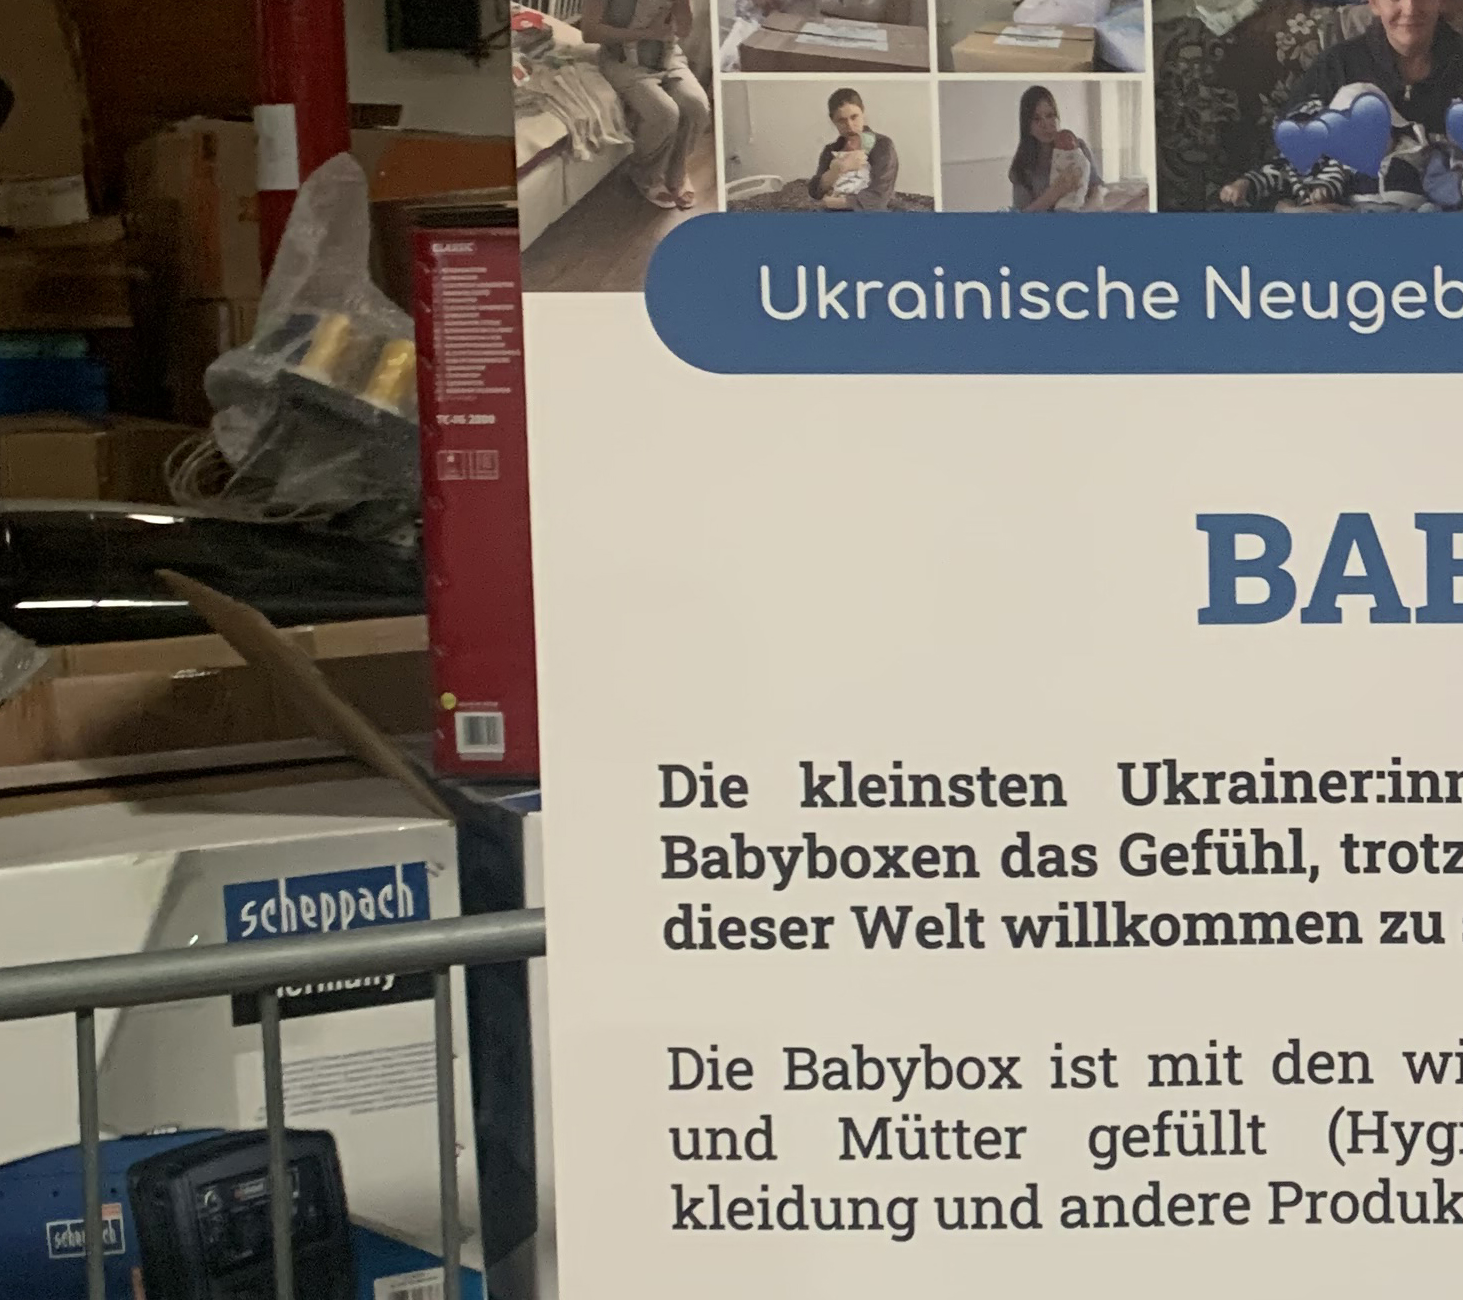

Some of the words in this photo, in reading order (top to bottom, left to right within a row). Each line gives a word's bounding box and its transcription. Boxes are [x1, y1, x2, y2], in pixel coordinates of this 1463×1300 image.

[761, 266, 1179, 320] Ukrainische
[658, 761, 748, 808] Die
[799, 761, 1067, 808] kleinsten
[660, 832, 980, 891] Babyboxen
[1001, 831, 1098, 878] das
[1120, 828, 1319, 883] Gefühl,
[240, 863, 415, 938] scheppach
[664, 903, 834, 950] dieser
[850, 902, 985, 949] Welt
[1001, 901, 1363, 948] willkommen
[1380, 911, 1445, 944] zu
[667, 1044, 753, 1091] Die
[783, 1044, 1022, 1102] Babybox
[1050, 1043, 1118, 1089] ist
[1148, 1040, 1243, 1087] mit
[1273, 1038, 1374, 1085] den
[669, 1114, 777, 1161] und
[839, 1114, 1027, 1160] Mütter
[1089, 1109, 1267, 1170] gefüllt
[671, 1184, 918, 1242] kleidung
[934, 1183, 1043, 1230] und
[1061, 1181, 1250, 1229] andere
